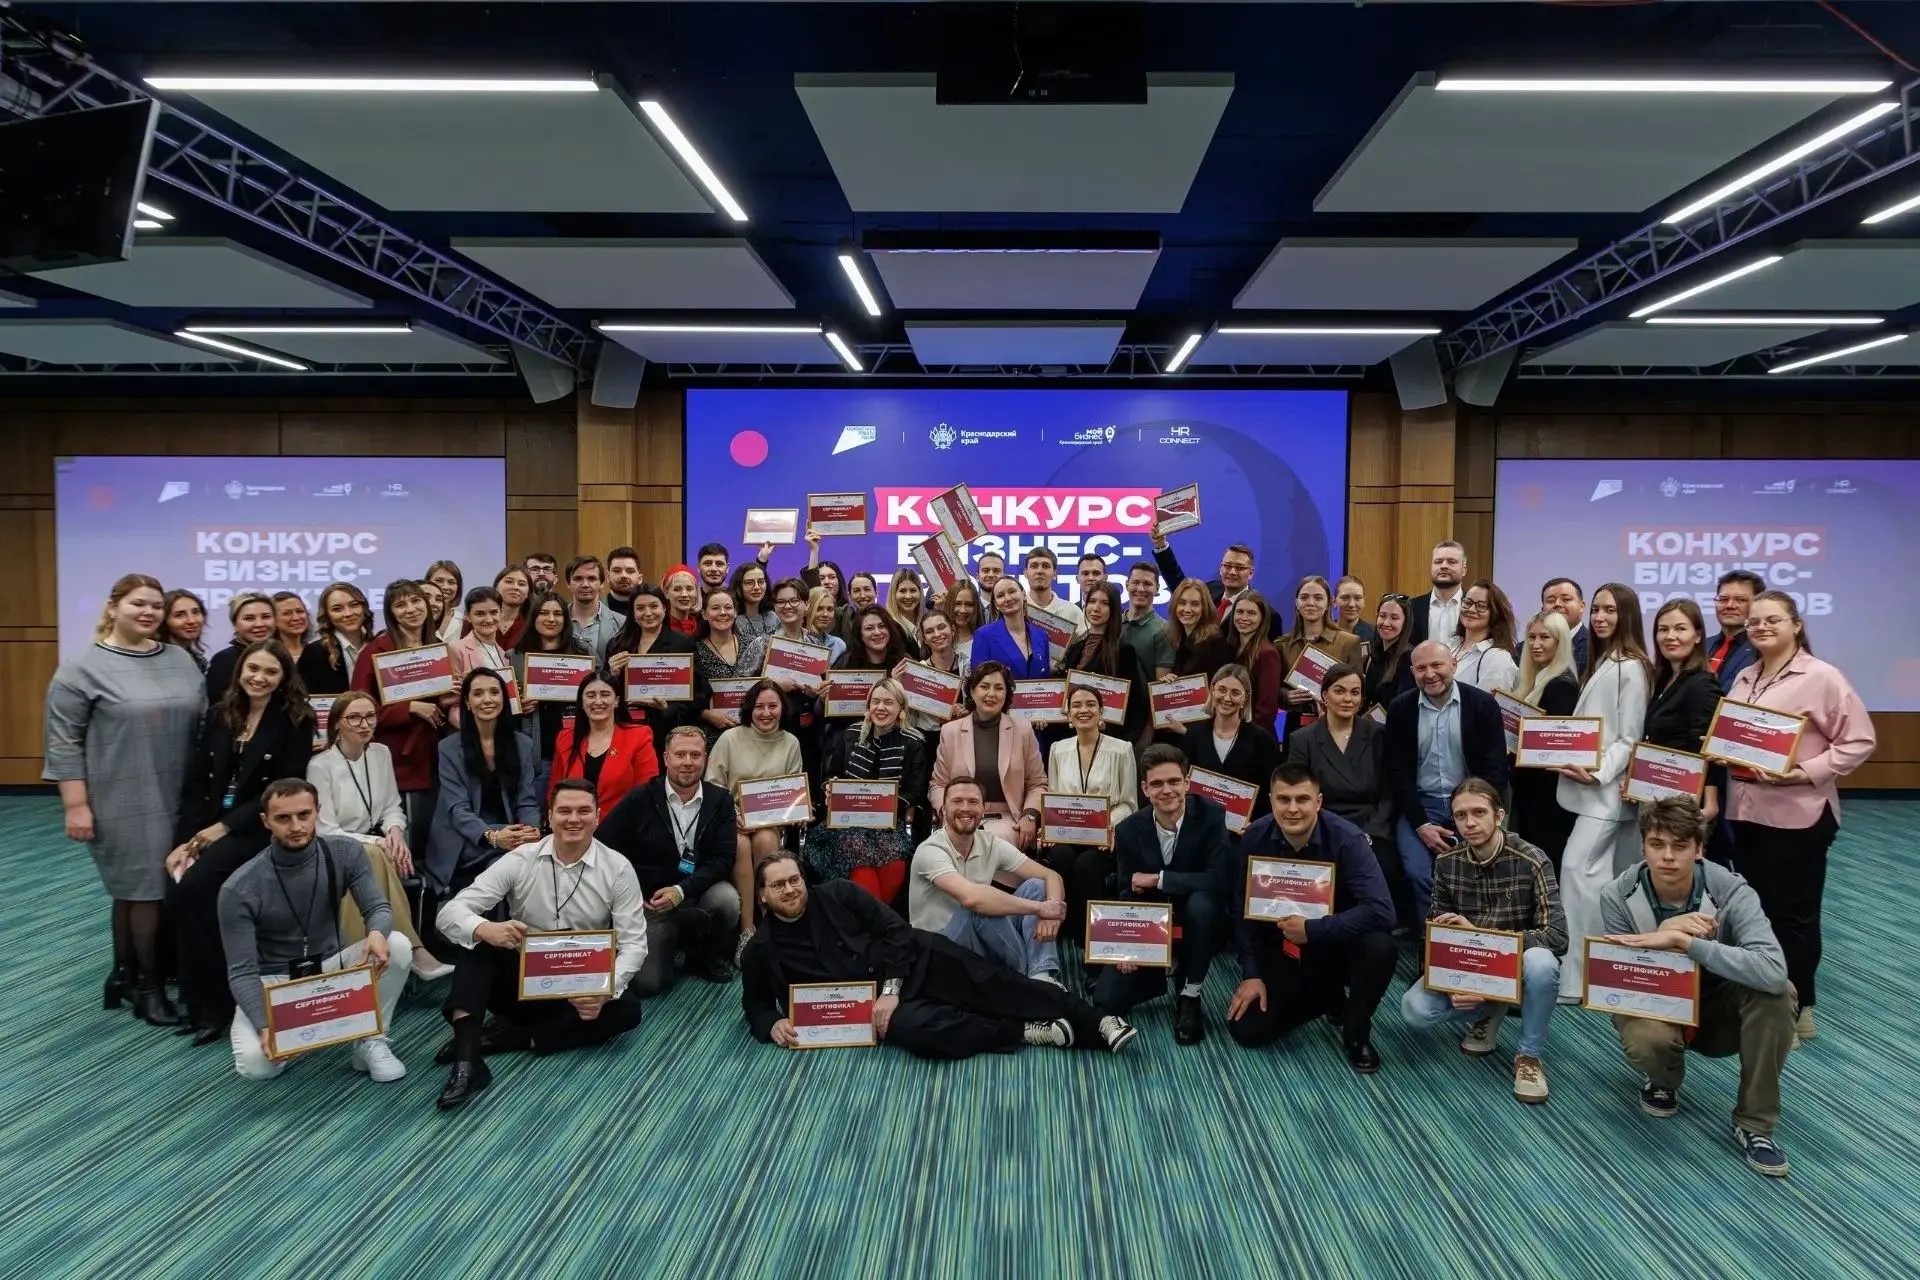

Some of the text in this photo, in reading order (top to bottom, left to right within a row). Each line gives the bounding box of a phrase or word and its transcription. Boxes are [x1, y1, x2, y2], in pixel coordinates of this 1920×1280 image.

[960, 430, 1017, 438] Краснодарский
[1170, 426, 1190, 436] HR
[196, 531, 378, 556] КОНКУРС
[1627, 531, 1820, 557] КОНКУРС
[204, 559, 372, 582] БИЗНЕС-
[394, 661, 433, 672] СЕРТИФИКАТ
[1733, 721, 1777, 736] СЕРТИФИКАТ
[1648, 763, 1687, 776] СЕРТИФИКАТ
[757, 790, 793, 800] СЕРТИФИКАТ
[1268, 877, 1313, 886] СЕРТИФИКАТ
[544, 951, 592, 960] СЕРТИФИКАТ
[1449, 946, 1498, 959] СЕРТИФИКАТ
[1612, 963, 1671, 977] СЕРТИФИКАТ
[295, 991, 351, 1009] СЕРТИФИКАТ
[811, 1002, 856, 1010] СЕРТИФИКАТ
